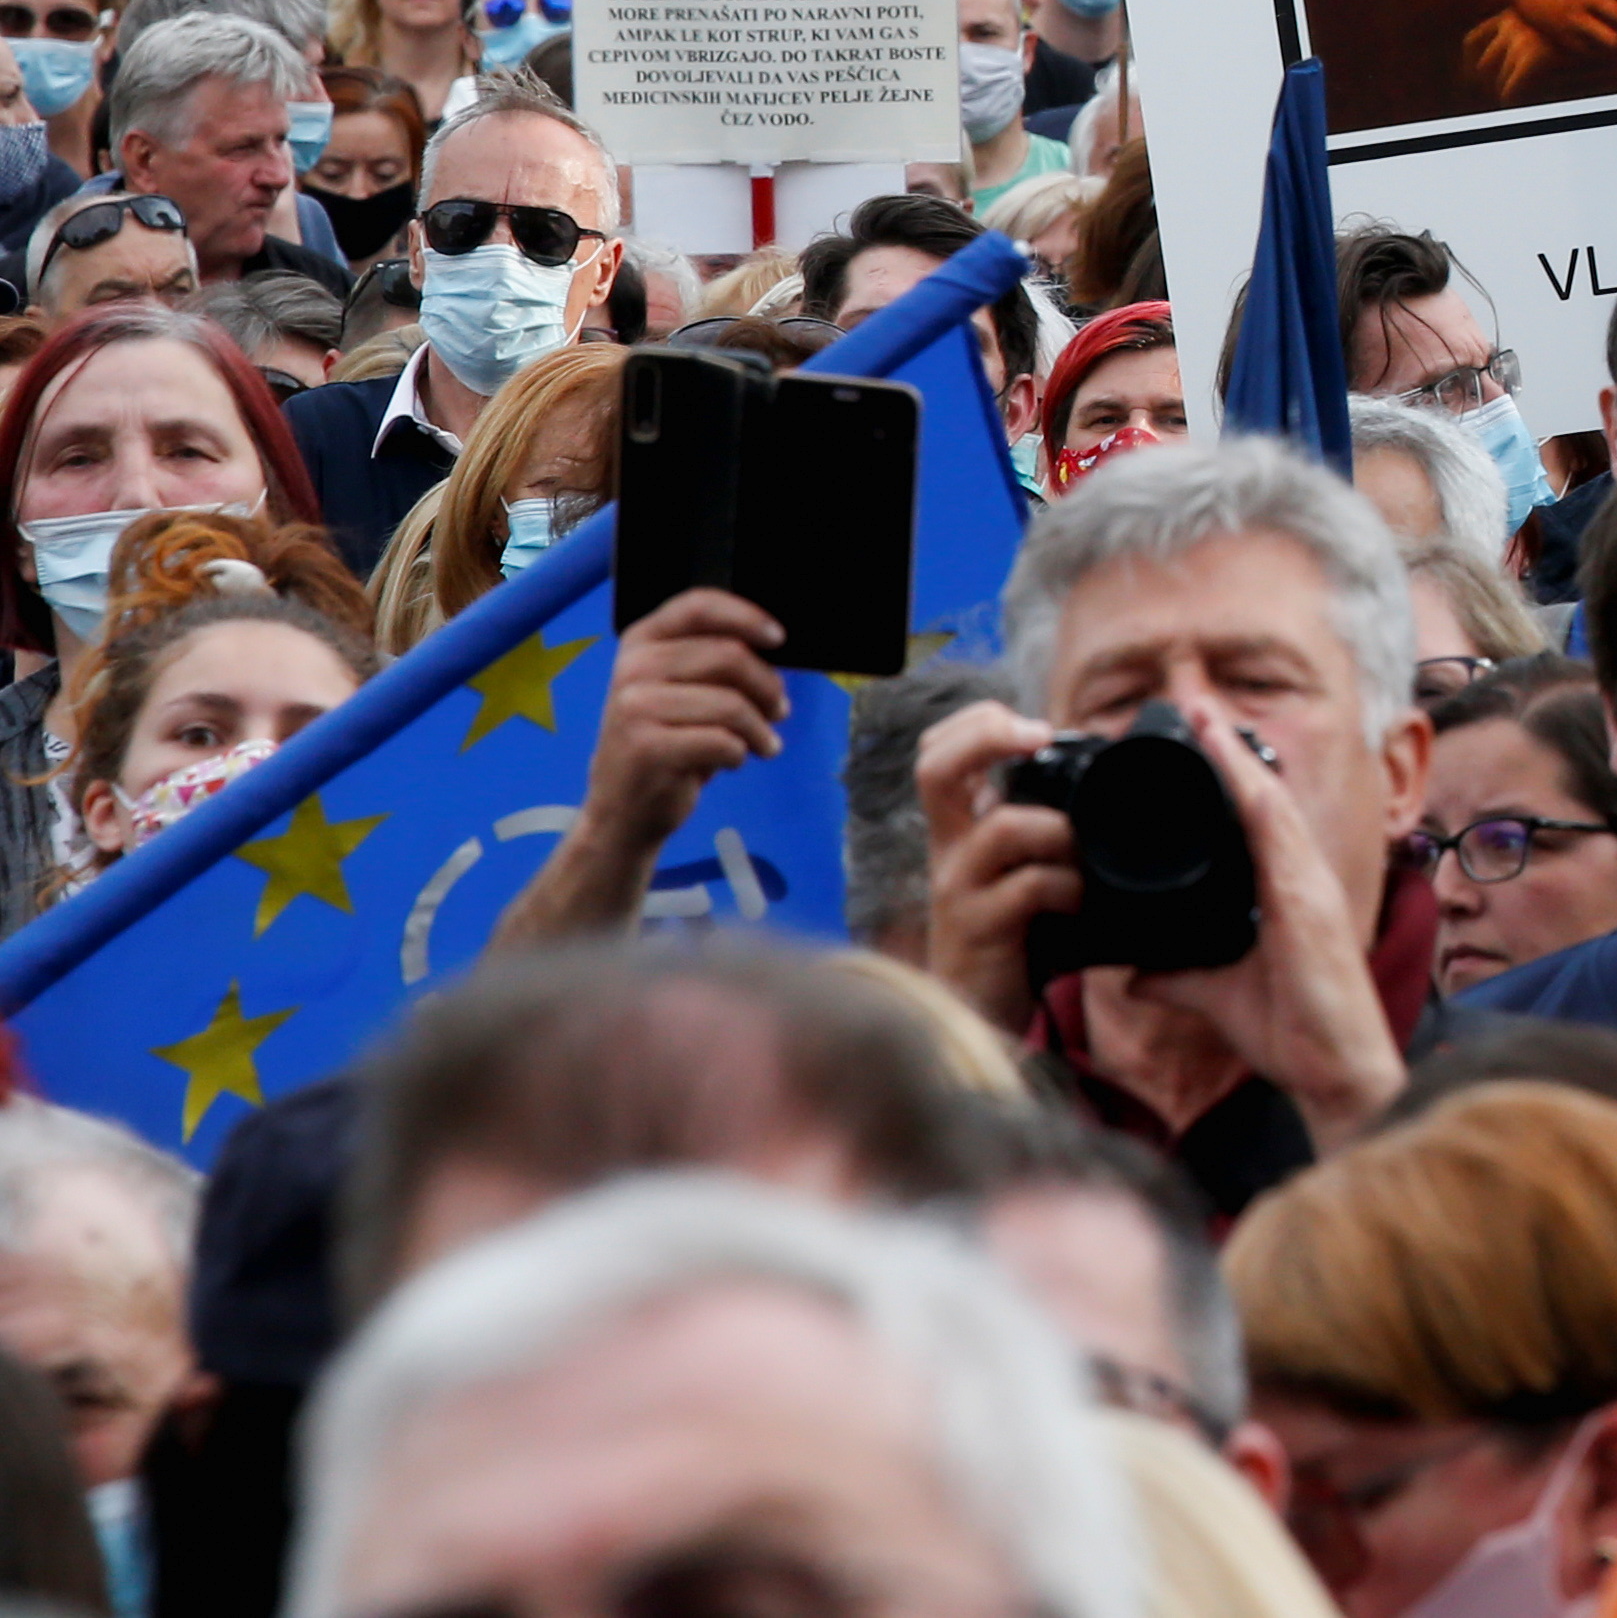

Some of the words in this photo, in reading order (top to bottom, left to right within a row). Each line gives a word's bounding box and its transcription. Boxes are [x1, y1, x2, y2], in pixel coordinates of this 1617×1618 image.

[609, 8, 659, 21] MORE
[665, 4, 758, 21] PRENAŠATI
[764, 7, 787, 21] PO
[792, 7, 871, 20] NARAVNI
[877, 6, 924, 20] POTI,
[615, 29, 676, 41] AMPAK
[681, 29, 702, 42] LE
[707, 29, 741, 42] KOT
[747, 28, 806, 43] STRUP,
[811, 28, 830, 41] KI
[835, 28, 874, 40] VAM
[879, 28, 905, 40] GA
[909, 27, 918, 39] S
[589, 49, 671, 63] CEPIVOM
[676, 49, 777, 63] VBRIZGAJO.
[782, 49, 807, 62] DO
[811, 49, 884, 62] TAKRAT
[889, 47, 945, 61] BOSTE
[636, 70, 753, 84] DOVOLJEVALI
[759, 71, 783, 84] DA
[787, 70, 819, 83] VAS
[824, 66, 900, 82] PEŠČICA
[603, 91, 720, 104] MEDICINSKIH
[726, 91, 814, 104] MAFIJCEV
[820, 90, 874, 103] PELJE
[879, 86, 933, 102] ŽEJNE
[721, 109, 753, 126] ČEZ
[758, 112, 814, 126] VODO.
